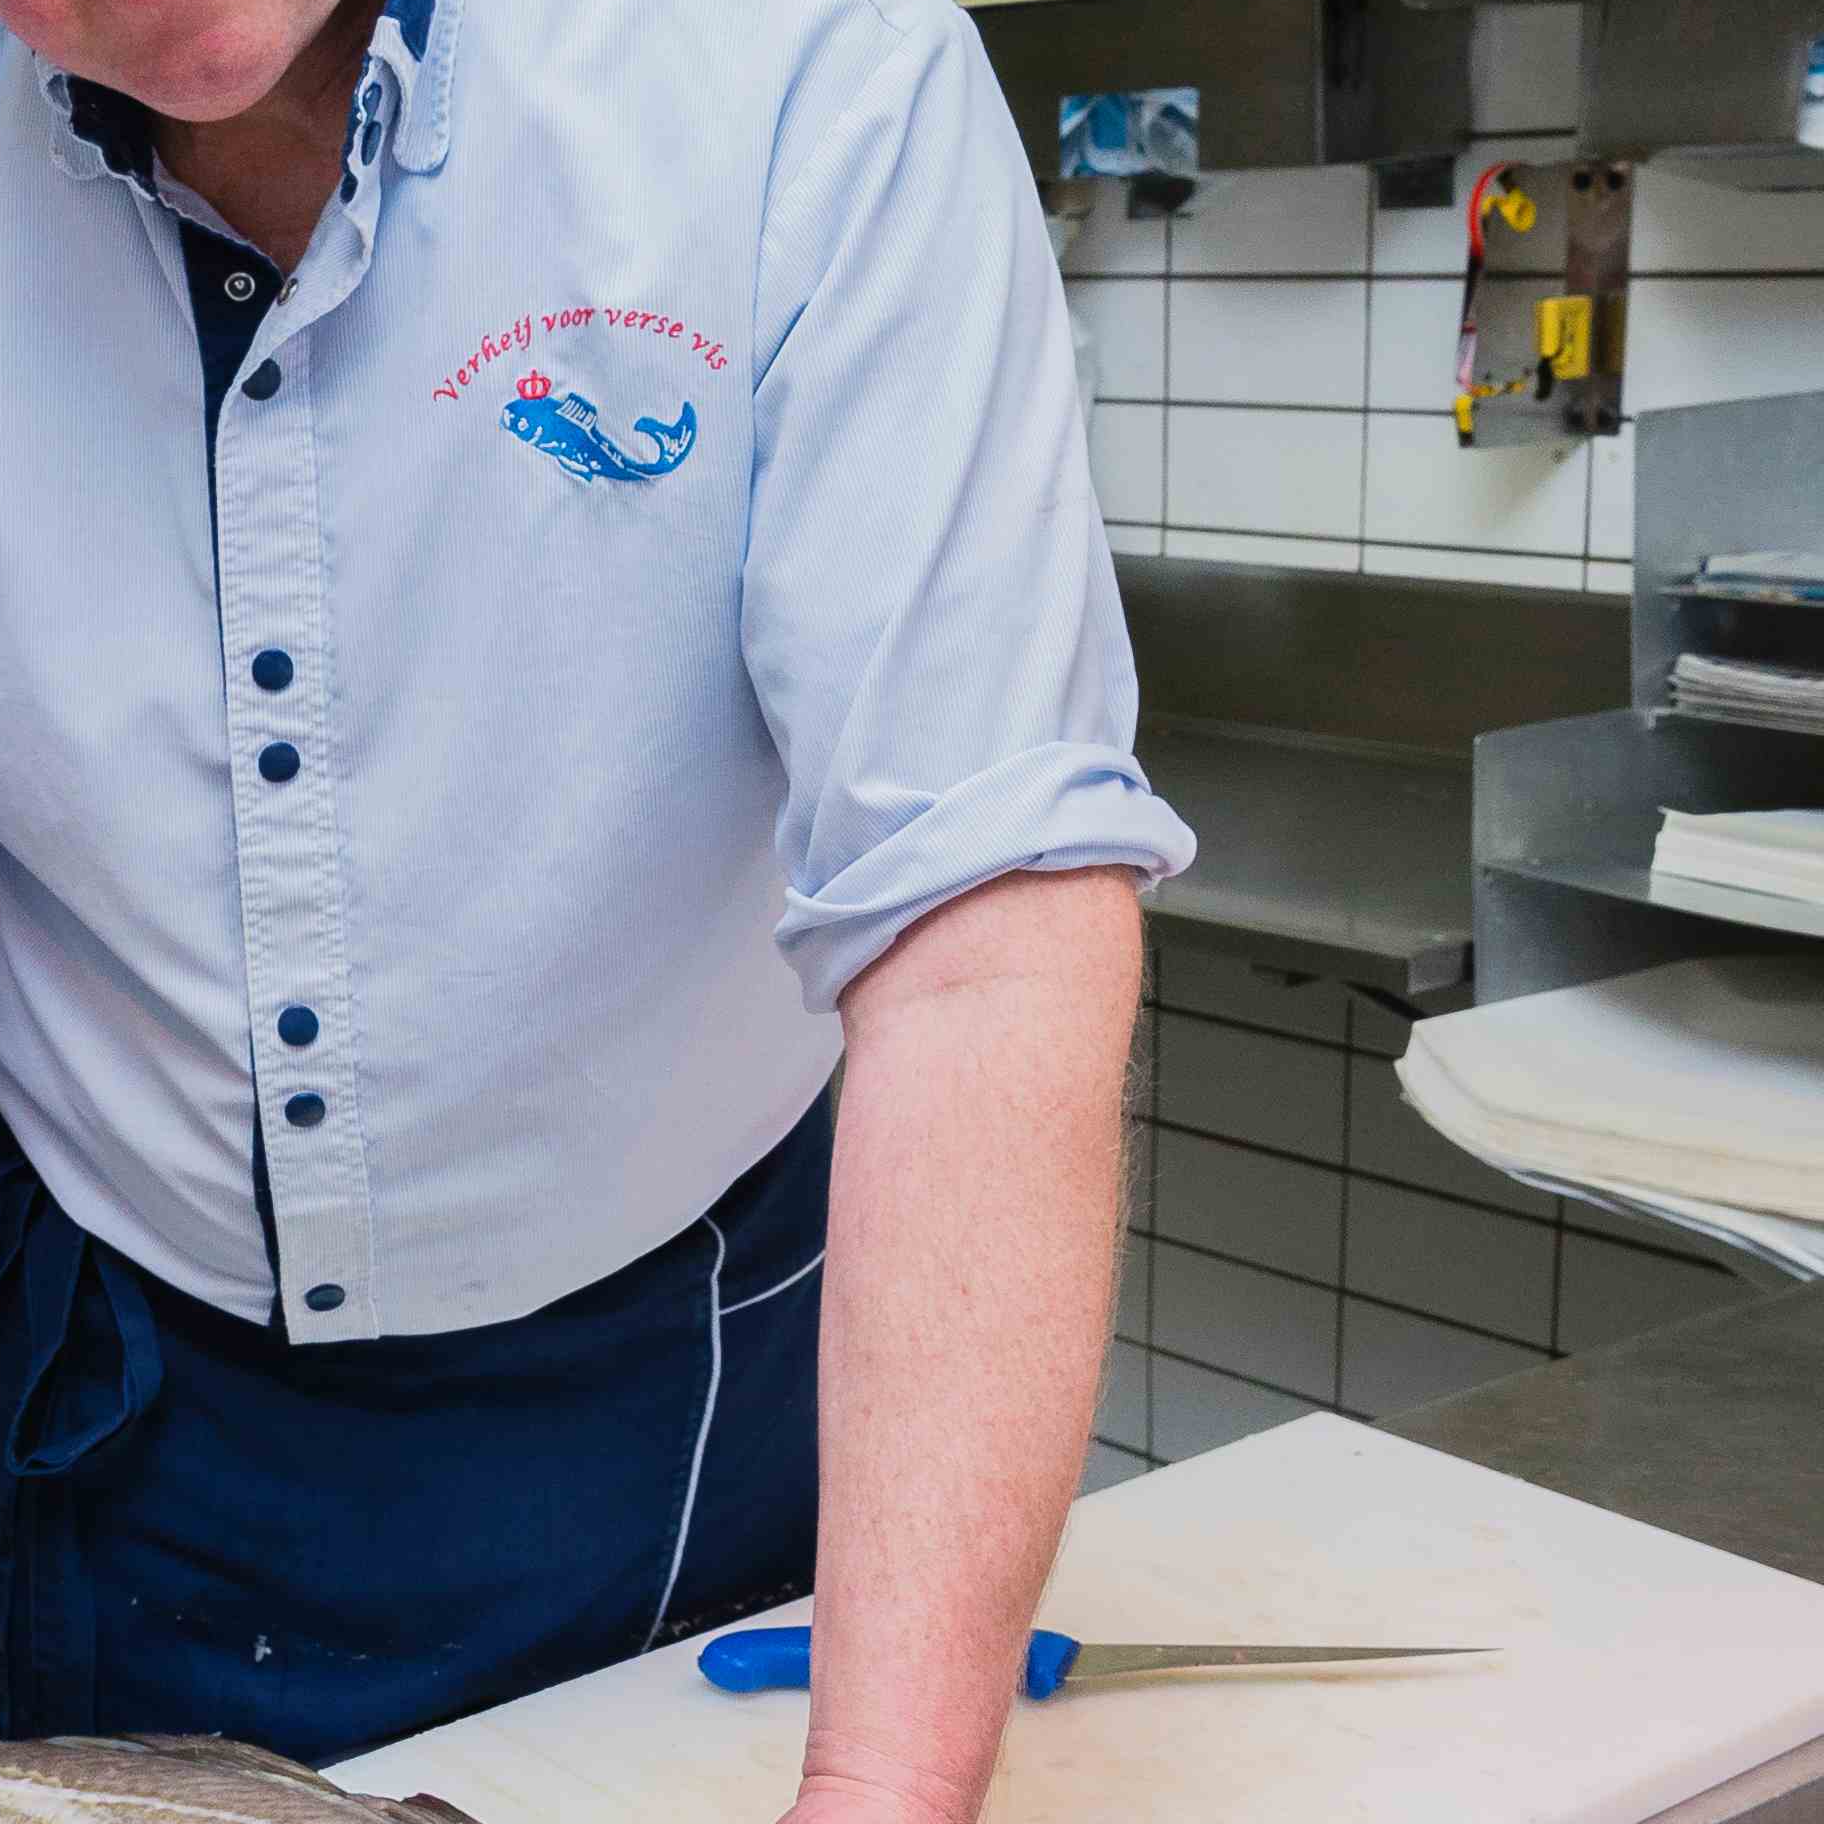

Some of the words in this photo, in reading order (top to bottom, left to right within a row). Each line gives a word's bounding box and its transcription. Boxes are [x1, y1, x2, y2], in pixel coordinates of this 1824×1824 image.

[433, 314, 533, 403] Verheij
[541, 306, 595, 333] voor
[604, 306, 685, 340] verse
[691, 331, 728, 371] vis
